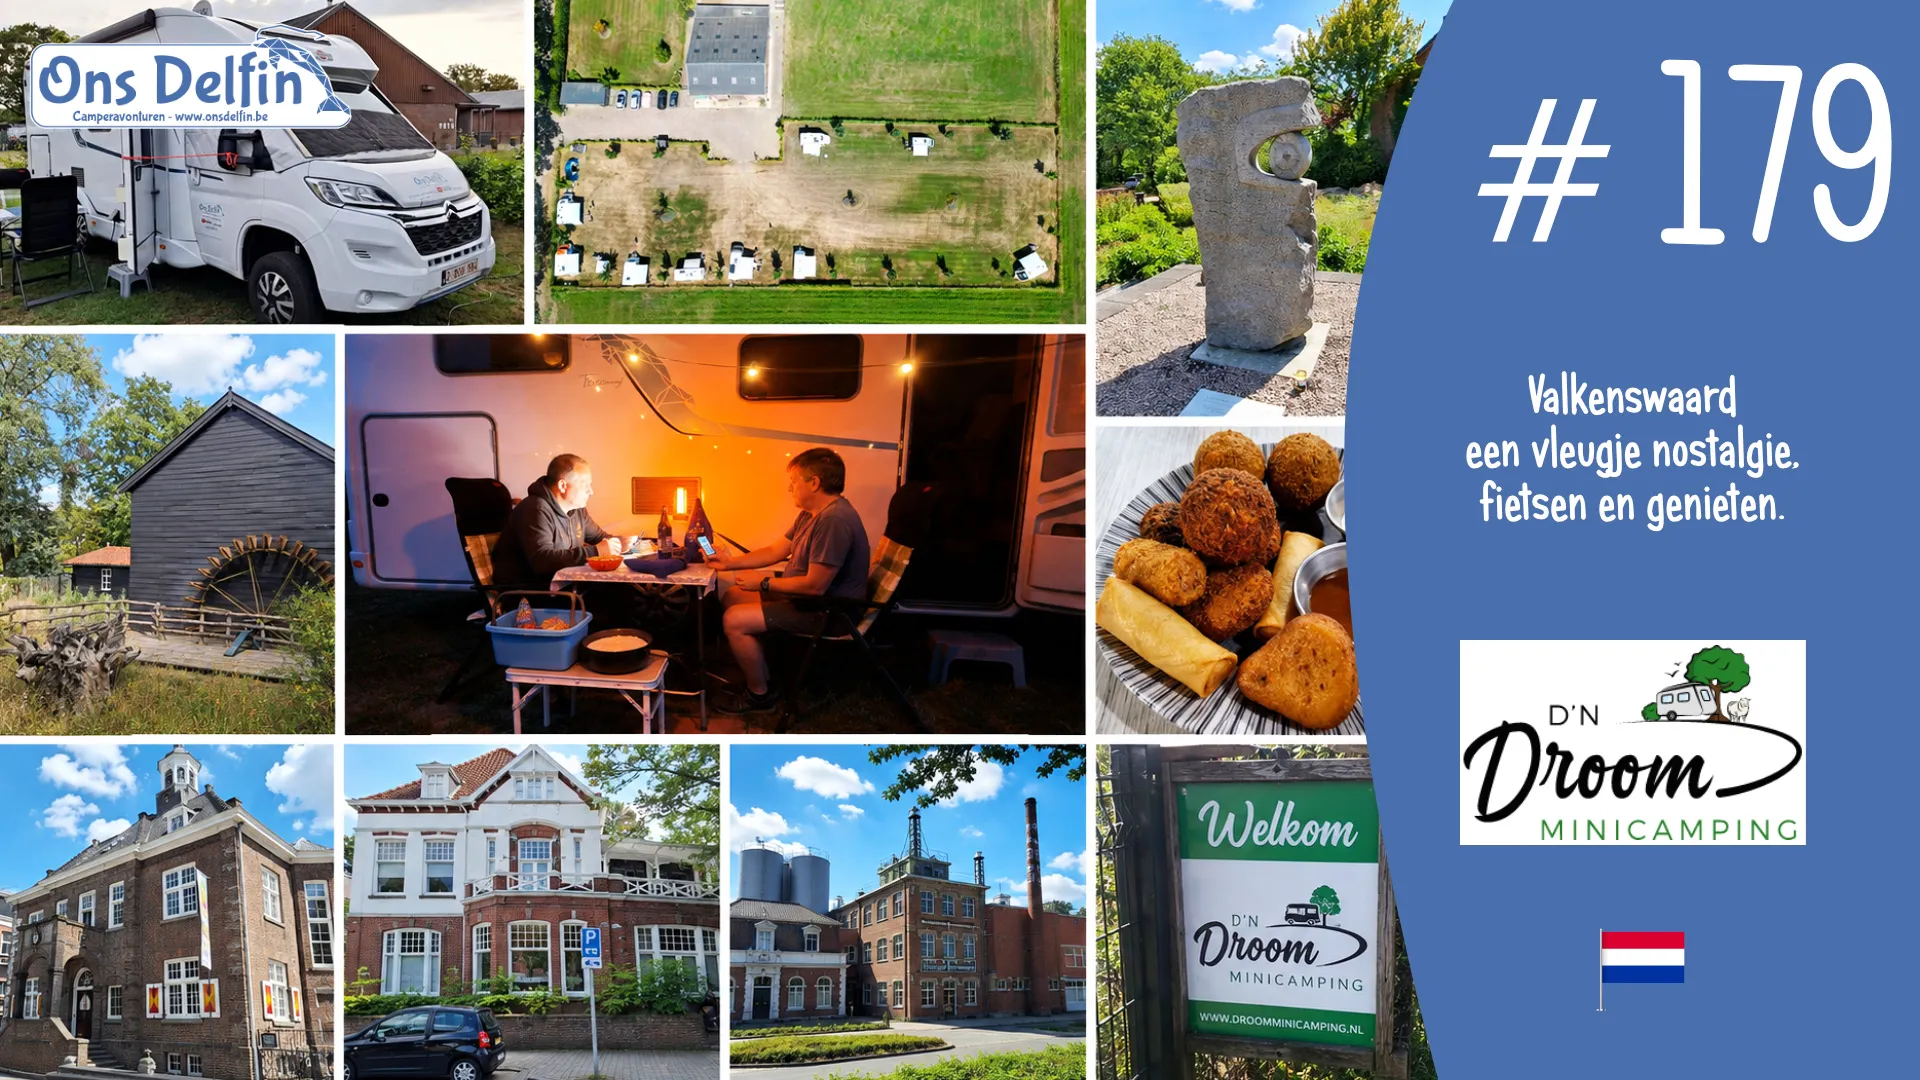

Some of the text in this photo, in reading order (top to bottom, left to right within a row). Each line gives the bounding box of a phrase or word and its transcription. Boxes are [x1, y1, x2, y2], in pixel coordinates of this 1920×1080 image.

[1198, 800, 1359, 848] Welkom
[1231, 914, 1259, 928] D'N
[586, 930, 597, 945] P
[1193, 921, 1319, 967] Droom
[1229, 971, 1364, 992] MINICAMPING
[1200, 1012, 1364, 1035] WWW.DROOMMINICAMPING.NL
